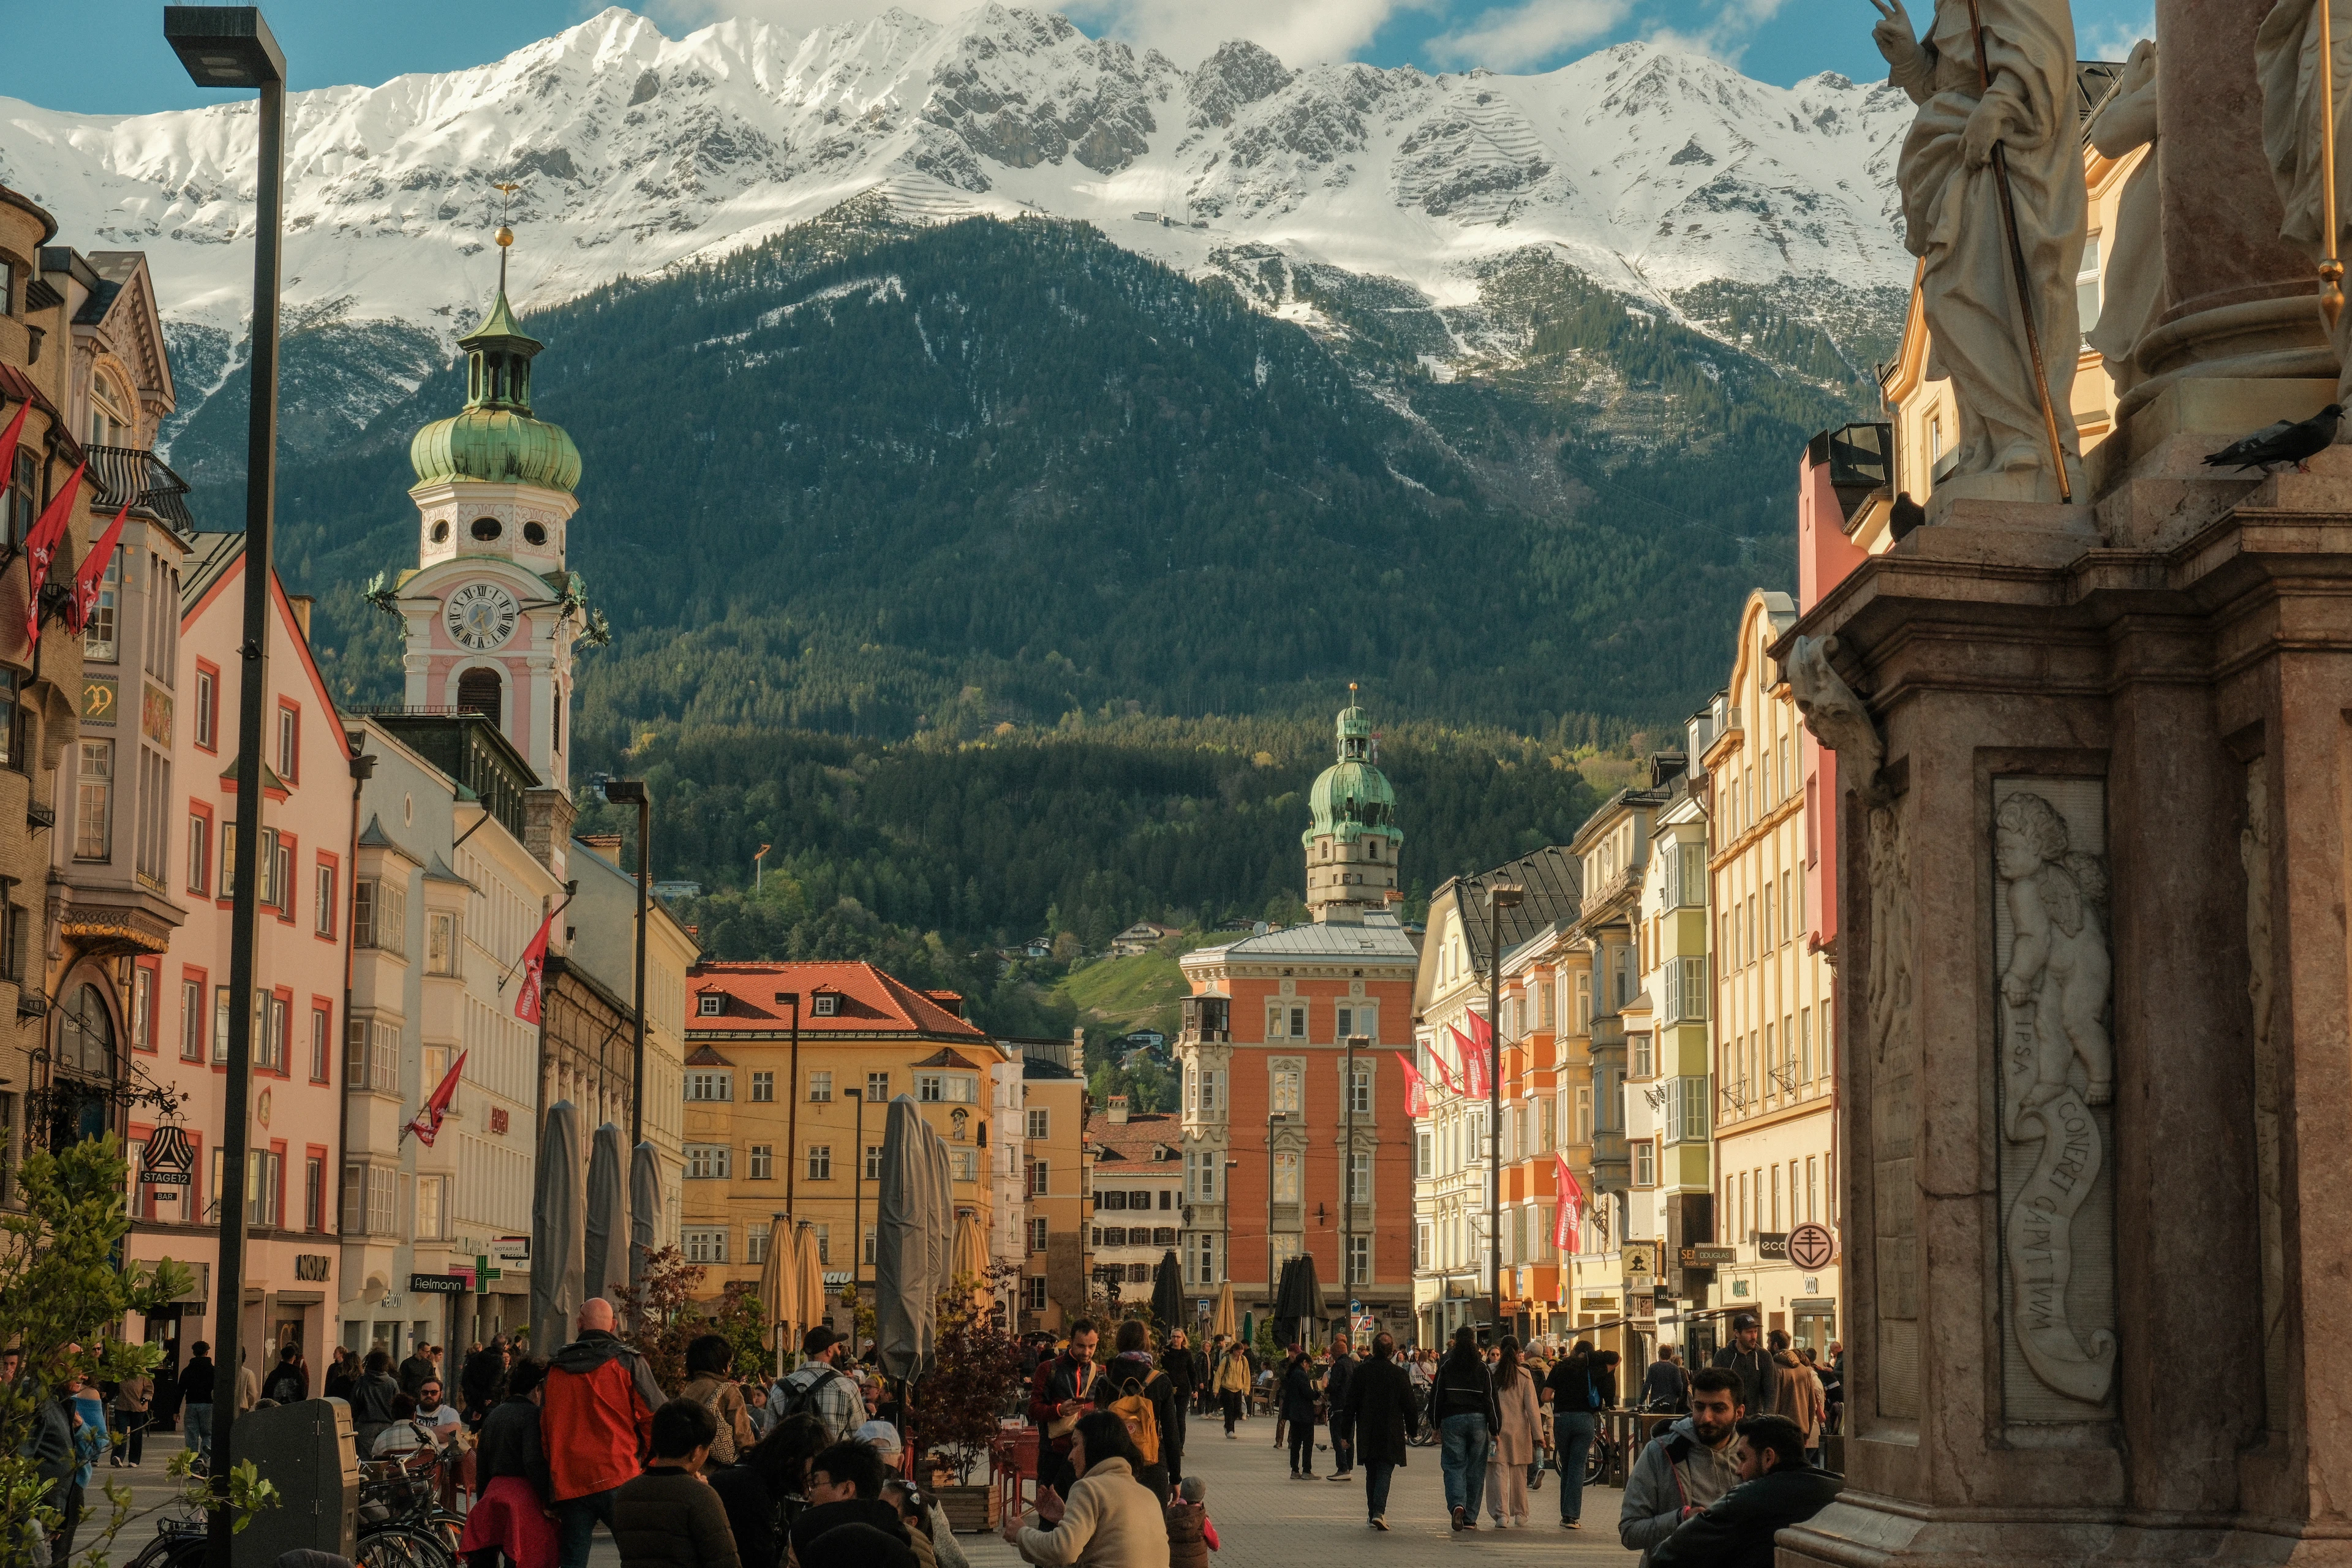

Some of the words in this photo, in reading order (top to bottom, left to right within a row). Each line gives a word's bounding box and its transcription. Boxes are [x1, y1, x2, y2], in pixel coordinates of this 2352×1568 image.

[462, 588, 473, 601] XI
[477, 586, 488, 597] XII
[453, 598, 464, 608] X
[499, 599, 510, 609] II
[450, 612, 461, 620] IX
[502, 612, 513, 621] III
[477, 636, 484, 648] VI
[491, 634, 499, 645] V
[2013, 1020, 2032, 1075] IPSA
[1468, 1059, 1477, 1095] INNSBRUCK
[144, 1172, 187, 1183] STAGE12
[1559, 1201, 1572, 1245] INNSBRUCK
[298, 1254, 332, 1281] NORZ
